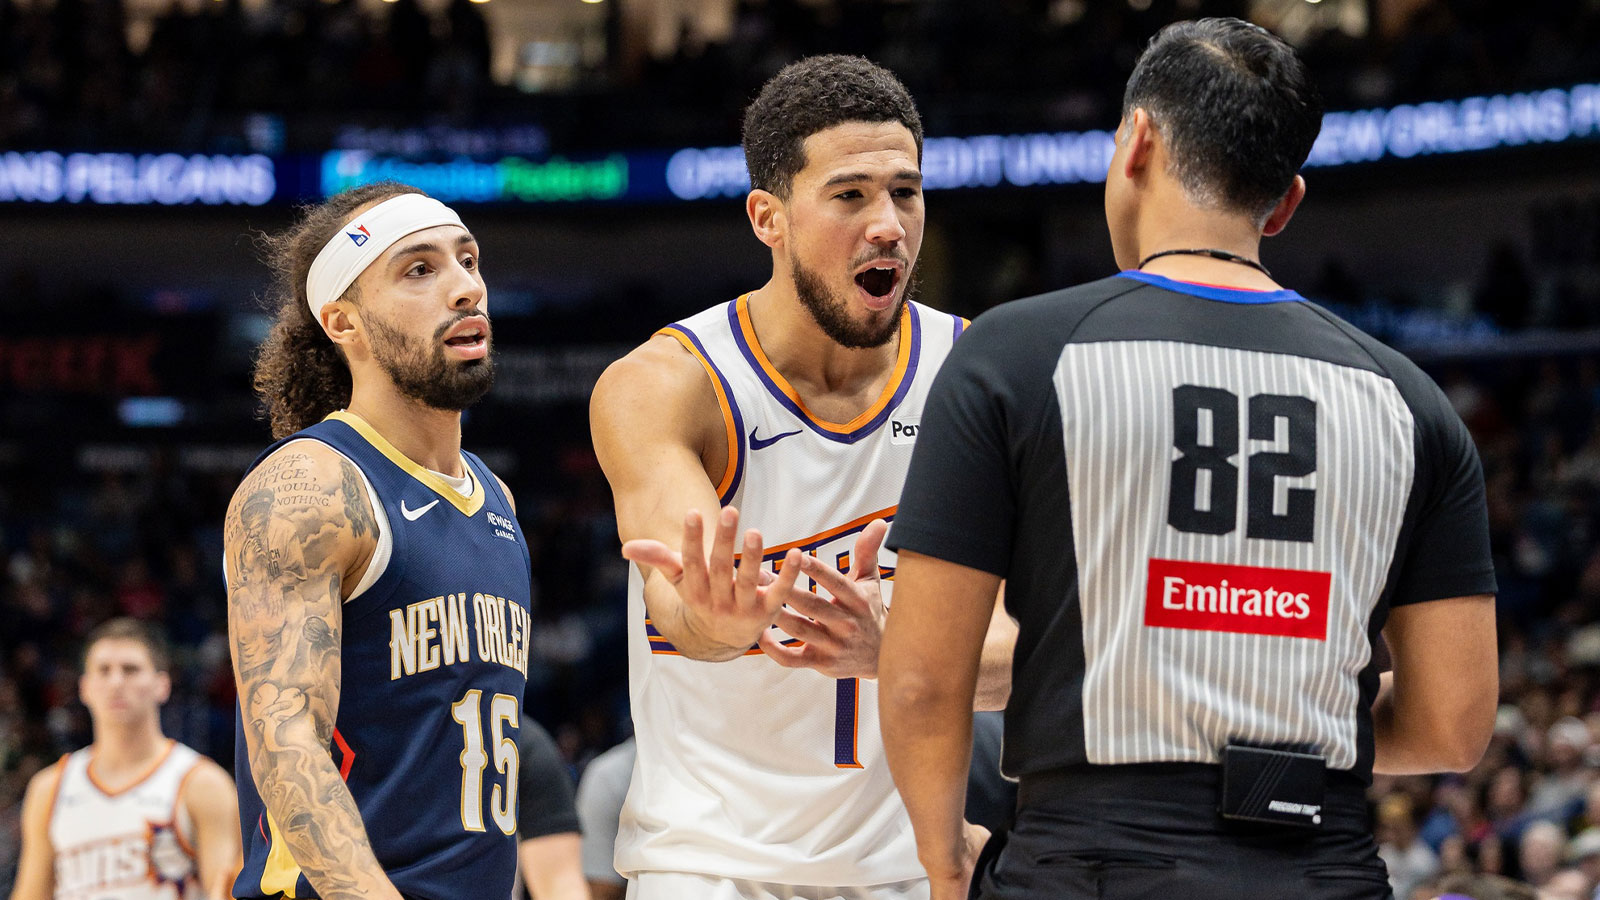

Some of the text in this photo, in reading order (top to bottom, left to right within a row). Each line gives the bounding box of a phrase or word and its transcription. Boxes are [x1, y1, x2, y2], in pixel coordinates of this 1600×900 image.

[1384, 88, 1570, 158] ORLEANS
[65, 151, 276, 206] PELICANS
[1168, 384, 1317, 543] 82
[389, 593, 470, 681] NEW
[1162, 576, 1310, 620] Emirates
[451, 688, 520, 836] 15
